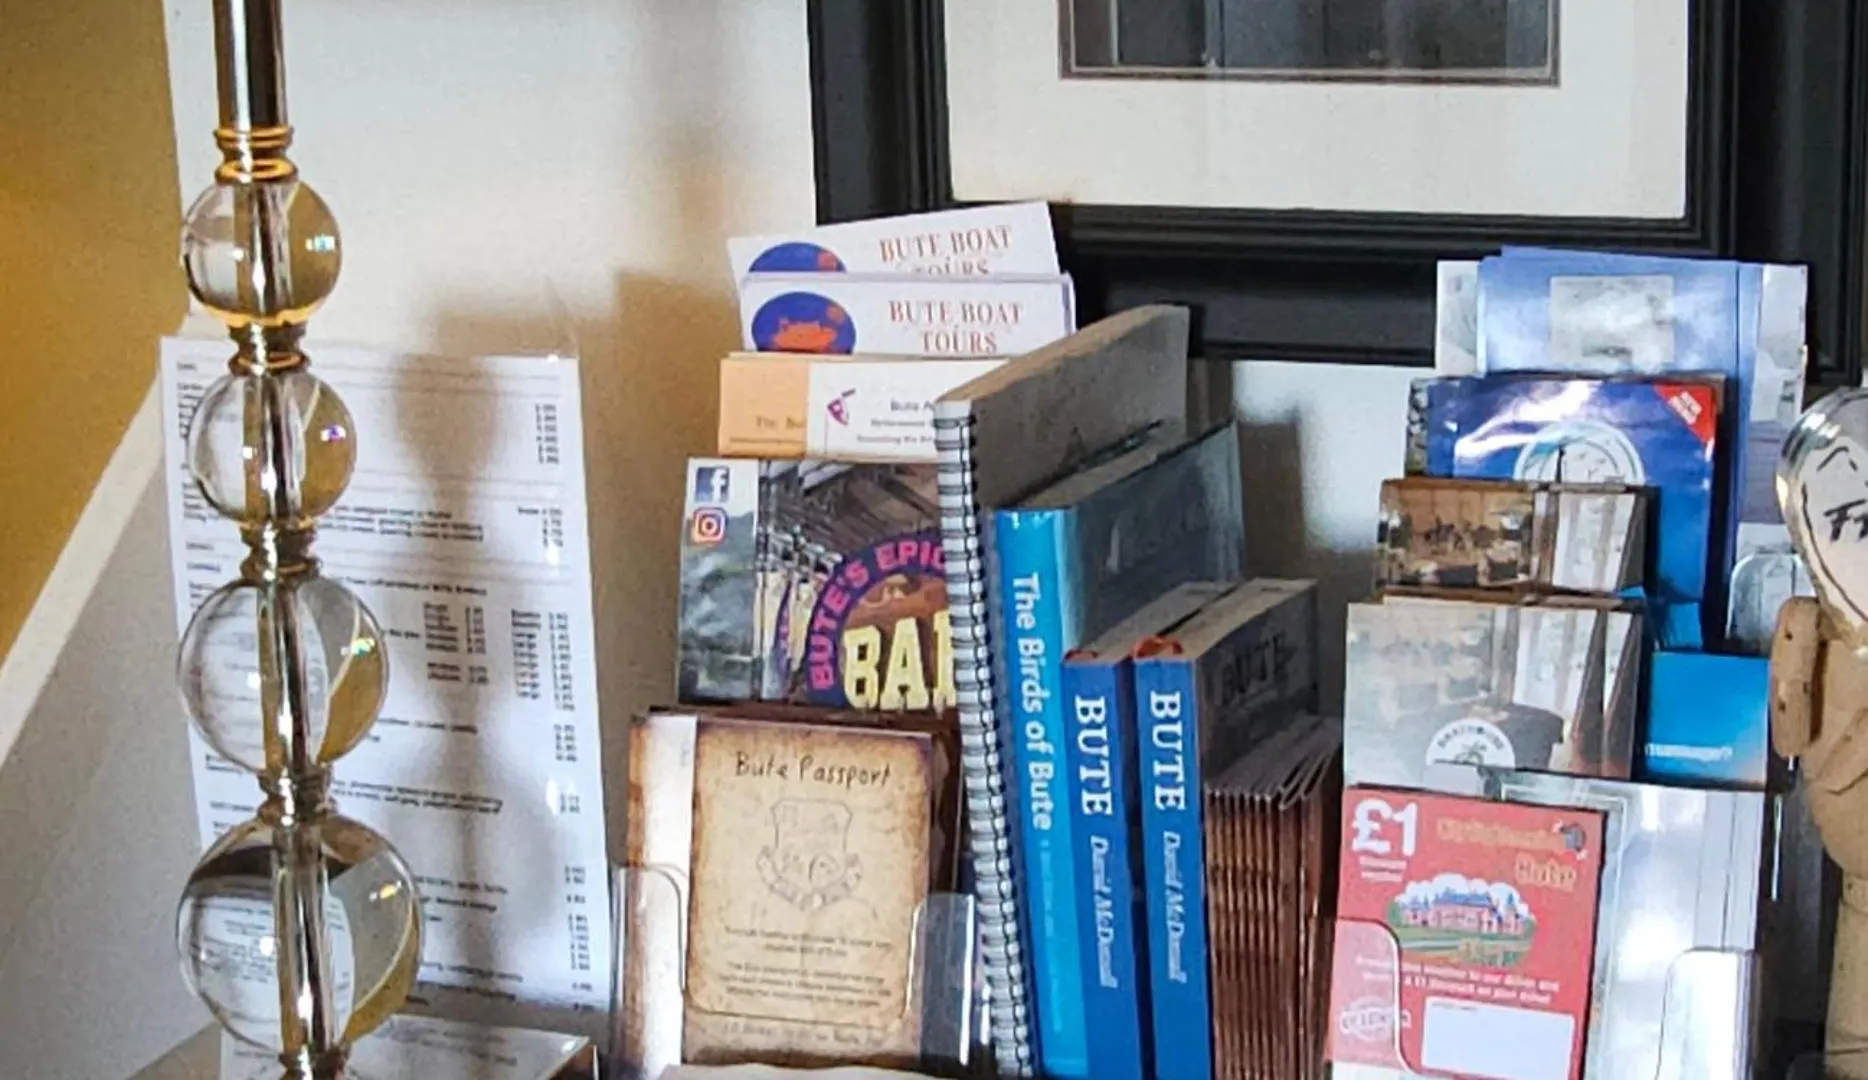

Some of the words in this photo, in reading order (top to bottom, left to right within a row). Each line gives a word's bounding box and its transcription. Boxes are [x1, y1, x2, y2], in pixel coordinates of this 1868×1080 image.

[879, 231, 941, 262] BUTE
[951, 225, 1012, 255] BOAT
[914, 256, 990, 275] OURS
[889, 300, 950, 325] BUTE
[961, 300, 1023, 325] BOAT
[922, 329, 998, 354] TOURS
[808, 559, 870, 691] BUTE'S
[1013, 572, 1040, 631] The
[1017, 638, 1050, 713] Birds
[1025, 721, 1055, 755] of
[1075, 695, 1113, 815] BUTE
[1150, 691, 1187, 810] BUTE
[735, 750, 789, 781] Bute
[799, 754, 892, 791] Passport
[1028, 761, 1055, 830] Bute
[1352, 798, 1418, 857] £1
